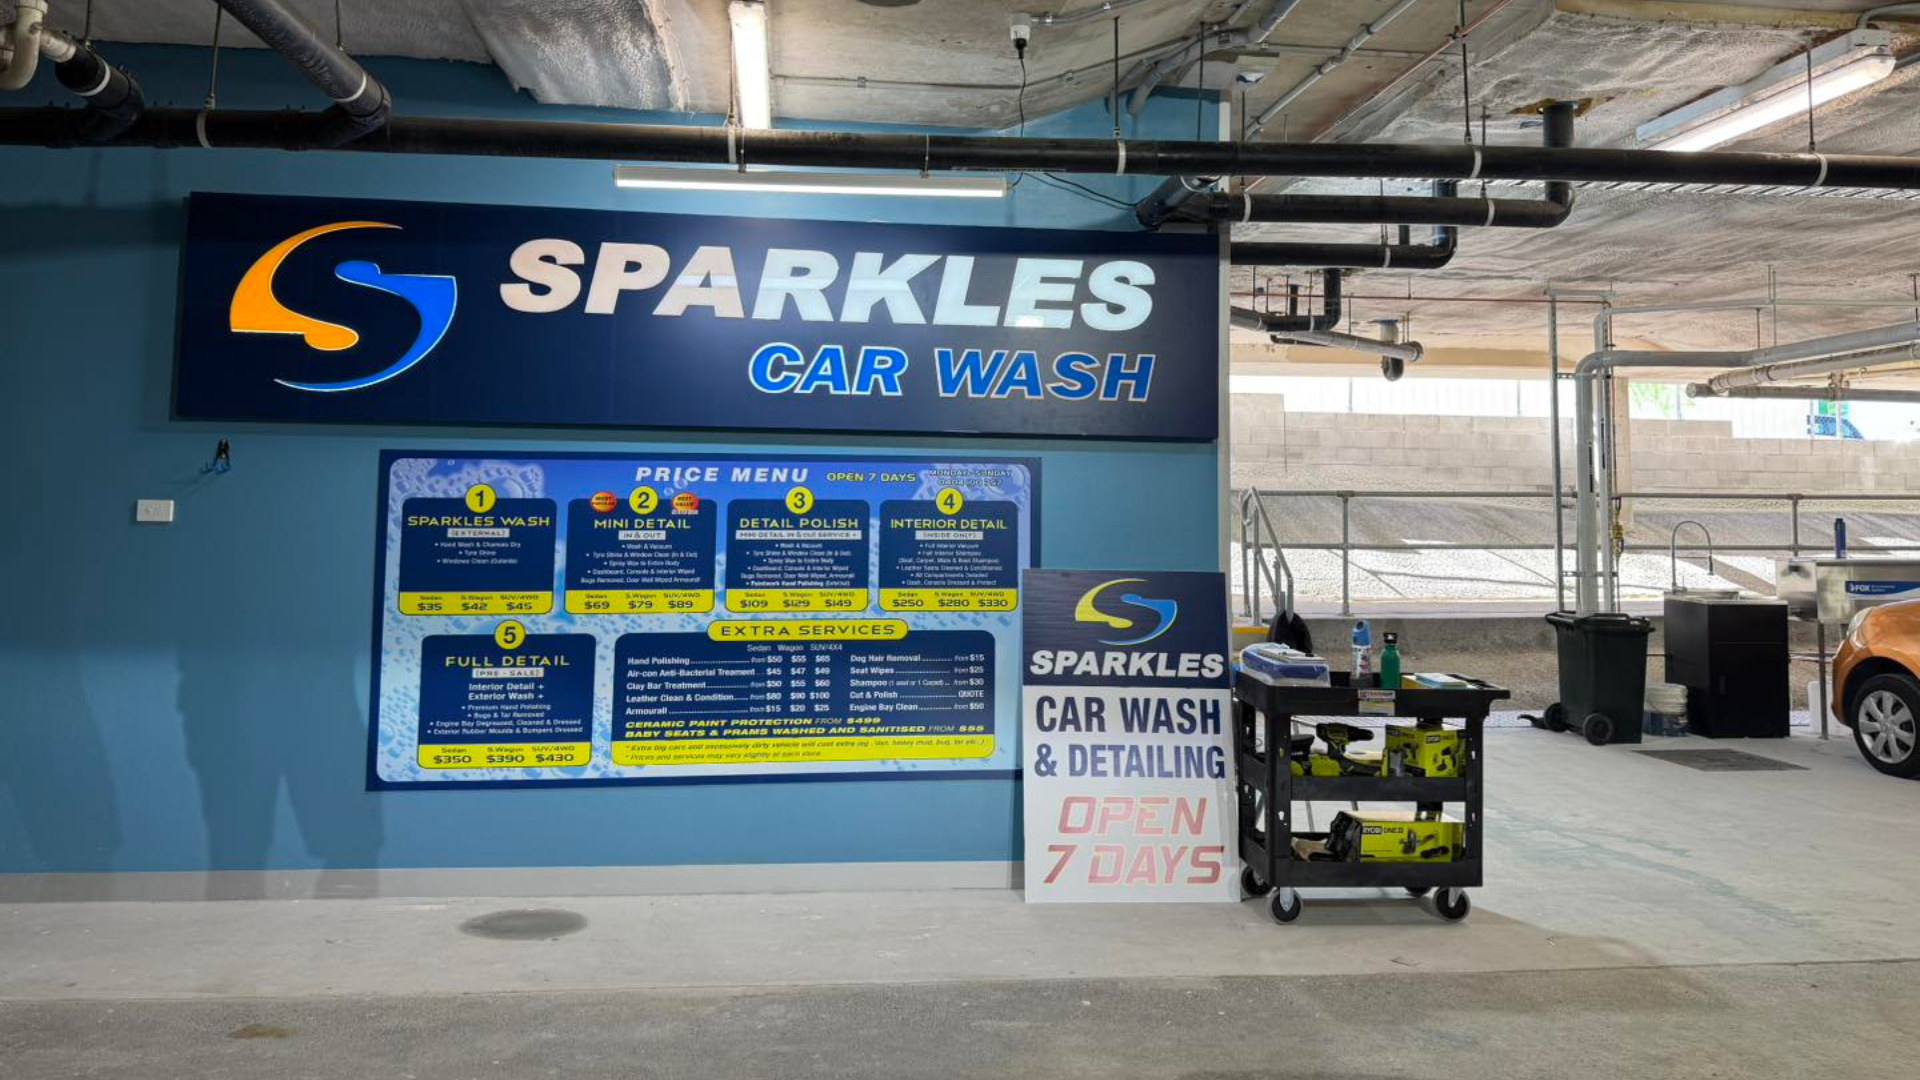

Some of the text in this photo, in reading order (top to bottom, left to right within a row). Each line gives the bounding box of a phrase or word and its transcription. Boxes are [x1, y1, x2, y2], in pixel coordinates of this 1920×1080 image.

[499, 238, 1155, 332] SPARKLES
[748, 341, 1156, 401] CAR WASH
[635, 467, 809, 483] PRICE MENU
[826, 472, 864, 483] OPEN
[868, 472, 876, 483] 7
[881, 472, 917, 483] DAYS
[475, 490, 484, 507] 1
[637, 492, 649, 509] 2
[793, 492, 805, 509] 3
[943, 493, 955, 509] 4
[407, 516, 550, 527] SPARKLES WASH
[594, 519, 691, 529] MINI DETAIL
[740, 518, 859, 529] DETAIL POLISH
[890, 519, 1008, 530] INTERIOR DETAIL
[417, 602, 532, 612] $35 $42 $45
[584, 600, 693, 610] $69 $79 $89
[740, 600, 768, 608] $109
[892, 599, 1008, 607] $250 $280 $330
[503, 626, 516, 644] 5
[721, 624, 895, 636] EXTRA SERVICES
[747, 644, 771, 652] Sedan
[777, 644, 804, 653] Wagon
[445, 655, 570, 667] FULL DETAIL
[628, 655, 830, 666] Hand Polishing $50 $55 $65
[850, 654, 866, 663] Dog
[868, 654, 884, 662] Hair
[886, 654, 921, 662] Removal
[1030, 650, 1224, 678] SPARKLES
[627, 669, 658, 678] Air-con
[659, 668, 716, 677] Anti-Bacterial
[766, 667, 782, 676] $45
[790, 667, 806, 675] $47
[815, 667, 830, 675] $49
[850, 667, 870, 675] Seat
[871, 667, 895, 676] Wipes
[468, 683, 503, 691] Interior
[507, 682, 535, 690] Detail
[626, 682, 645, 691] Clay
[664, 681, 706, 689] Treatment
[766, 680, 782, 688] $50
[814, 679, 830, 687] $60
[850, 679, 887, 688] Shampoo
[468, 692, 506, 700] Exterior
[508, 692, 534, 700] Wash
[626, 692, 830, 703] Leather Clean & Condition $80 $90 $100
[850, 690, 984, 699] Cut & Polish QUOTE
[625, 704, 830, 715] Armourall $15 $20 $25
[850, 703, 877, 712] Engine
[878, 703, 894, 712] Bay
[895, 703, 918, 711] Clean
[1036, 696, 1221, 735] CAR WASH
[625, 721, 685, 729] CERAMIC
[688, 719, 728, 728] PAINT
[730, 718, 813, 726] PROTECTION
[846, 717, 881, 725] $499
[625, 730, 661, 738] BABY
[709, 729, 719, 737] &
[723, 728, 769, 736] PRAMS
[772, 727, 826, 735] WASHED
[829, 726, 856, 734] AND
[859, 725, 926, 733] SANITISED
[433, 754, 574, 764] $350 $390 $430
[1034, 743, 1226, 779] & DETAILING
[1057, 796, 1208, 836] OPEN
[1043, 844, 1225, 885] 7 DAYS
